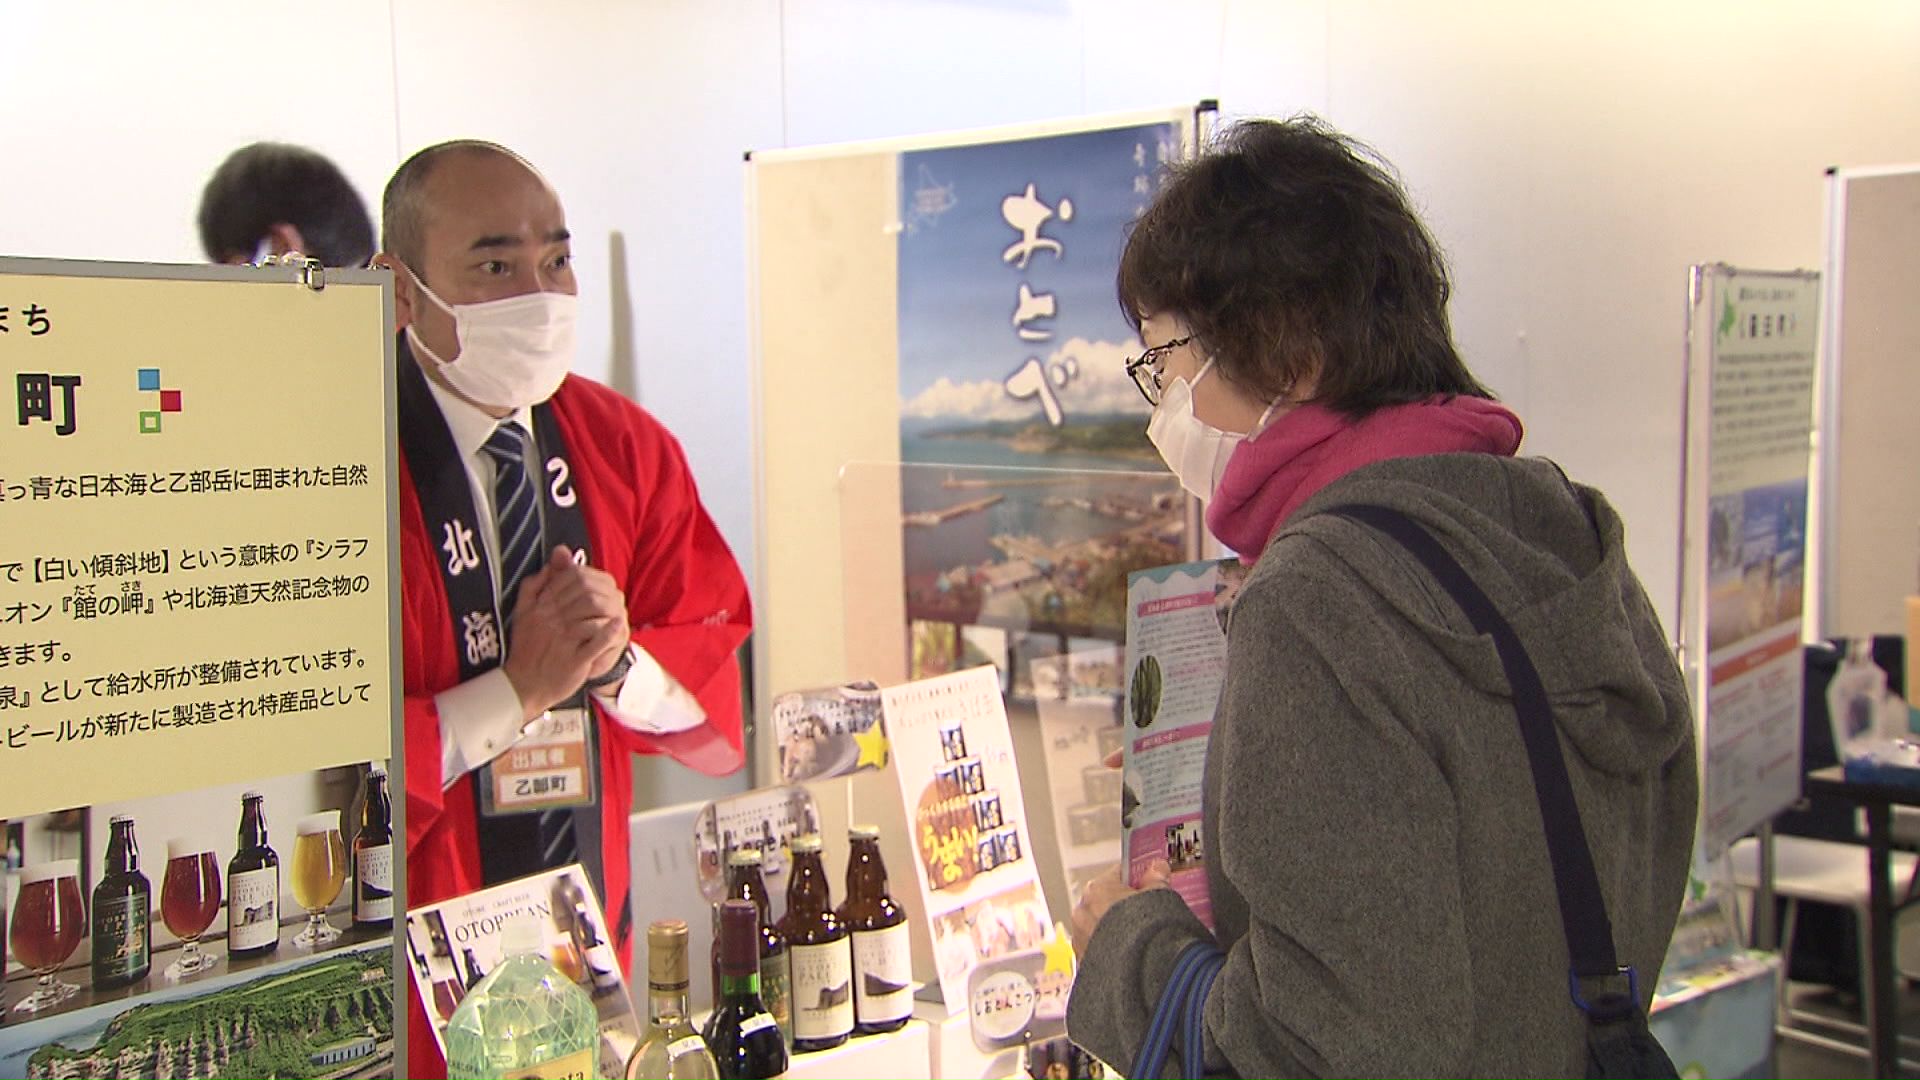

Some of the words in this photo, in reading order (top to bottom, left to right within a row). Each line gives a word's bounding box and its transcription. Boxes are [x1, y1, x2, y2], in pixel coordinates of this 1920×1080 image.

[1002, 182, 1079, 427] おとべ
[16, 373, 82, 437] 町
[73, 584, 96, 596] たて
[121, 580, 141, 592] さき
[0, 683, 372, 748] ビールが新たに製造され特産品として
[515, 774, 567, 796] 乙部町
